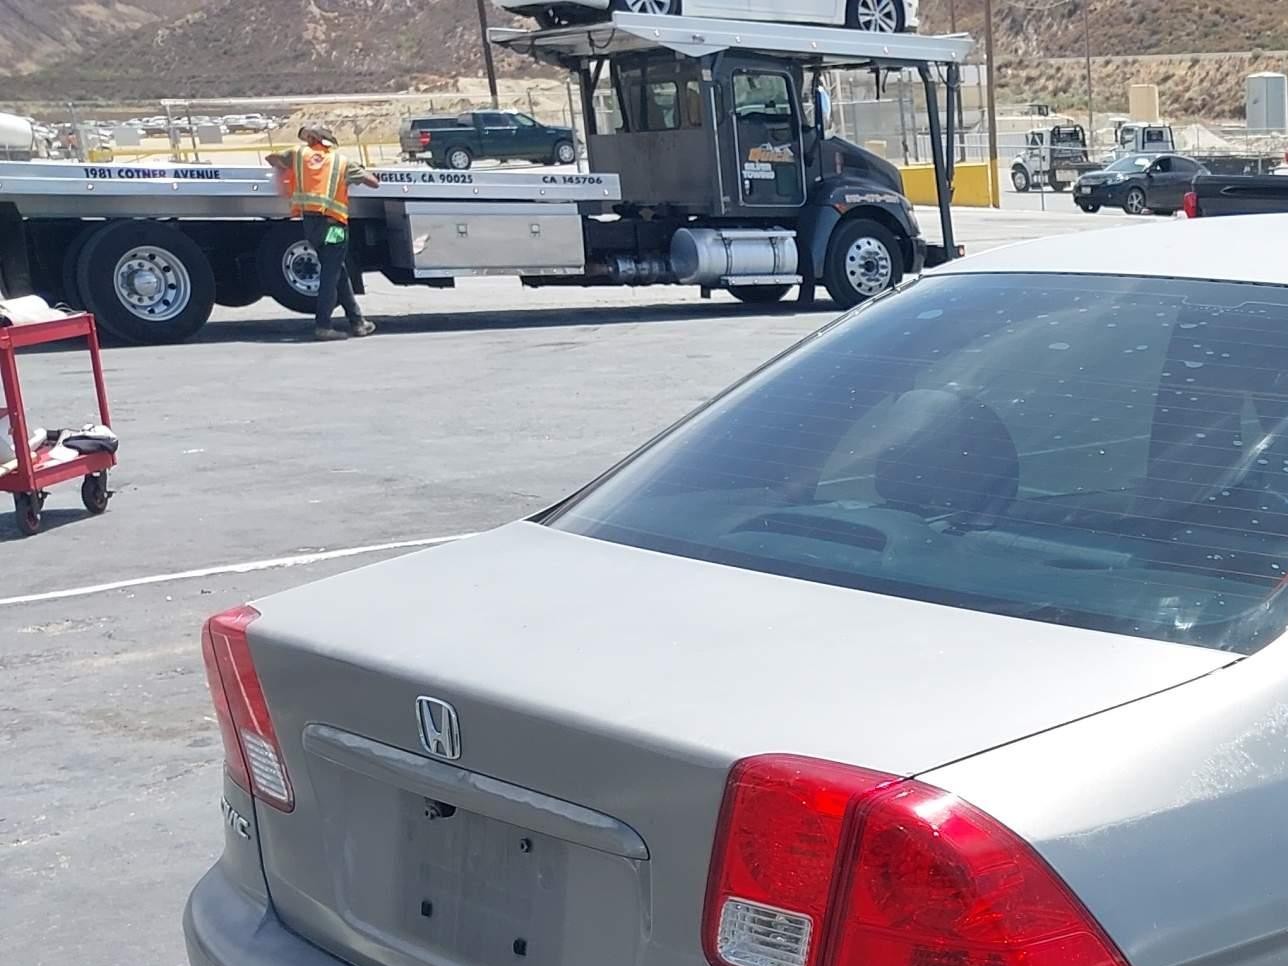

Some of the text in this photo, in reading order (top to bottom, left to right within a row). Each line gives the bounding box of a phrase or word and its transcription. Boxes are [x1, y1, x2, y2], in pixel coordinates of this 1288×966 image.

[84, 168, 221, 179] 1981 COTNER AVENUE
[372, 172, 473, 184] NGELES, CA 90025
[542, 175, 603, 185] CA 145706
